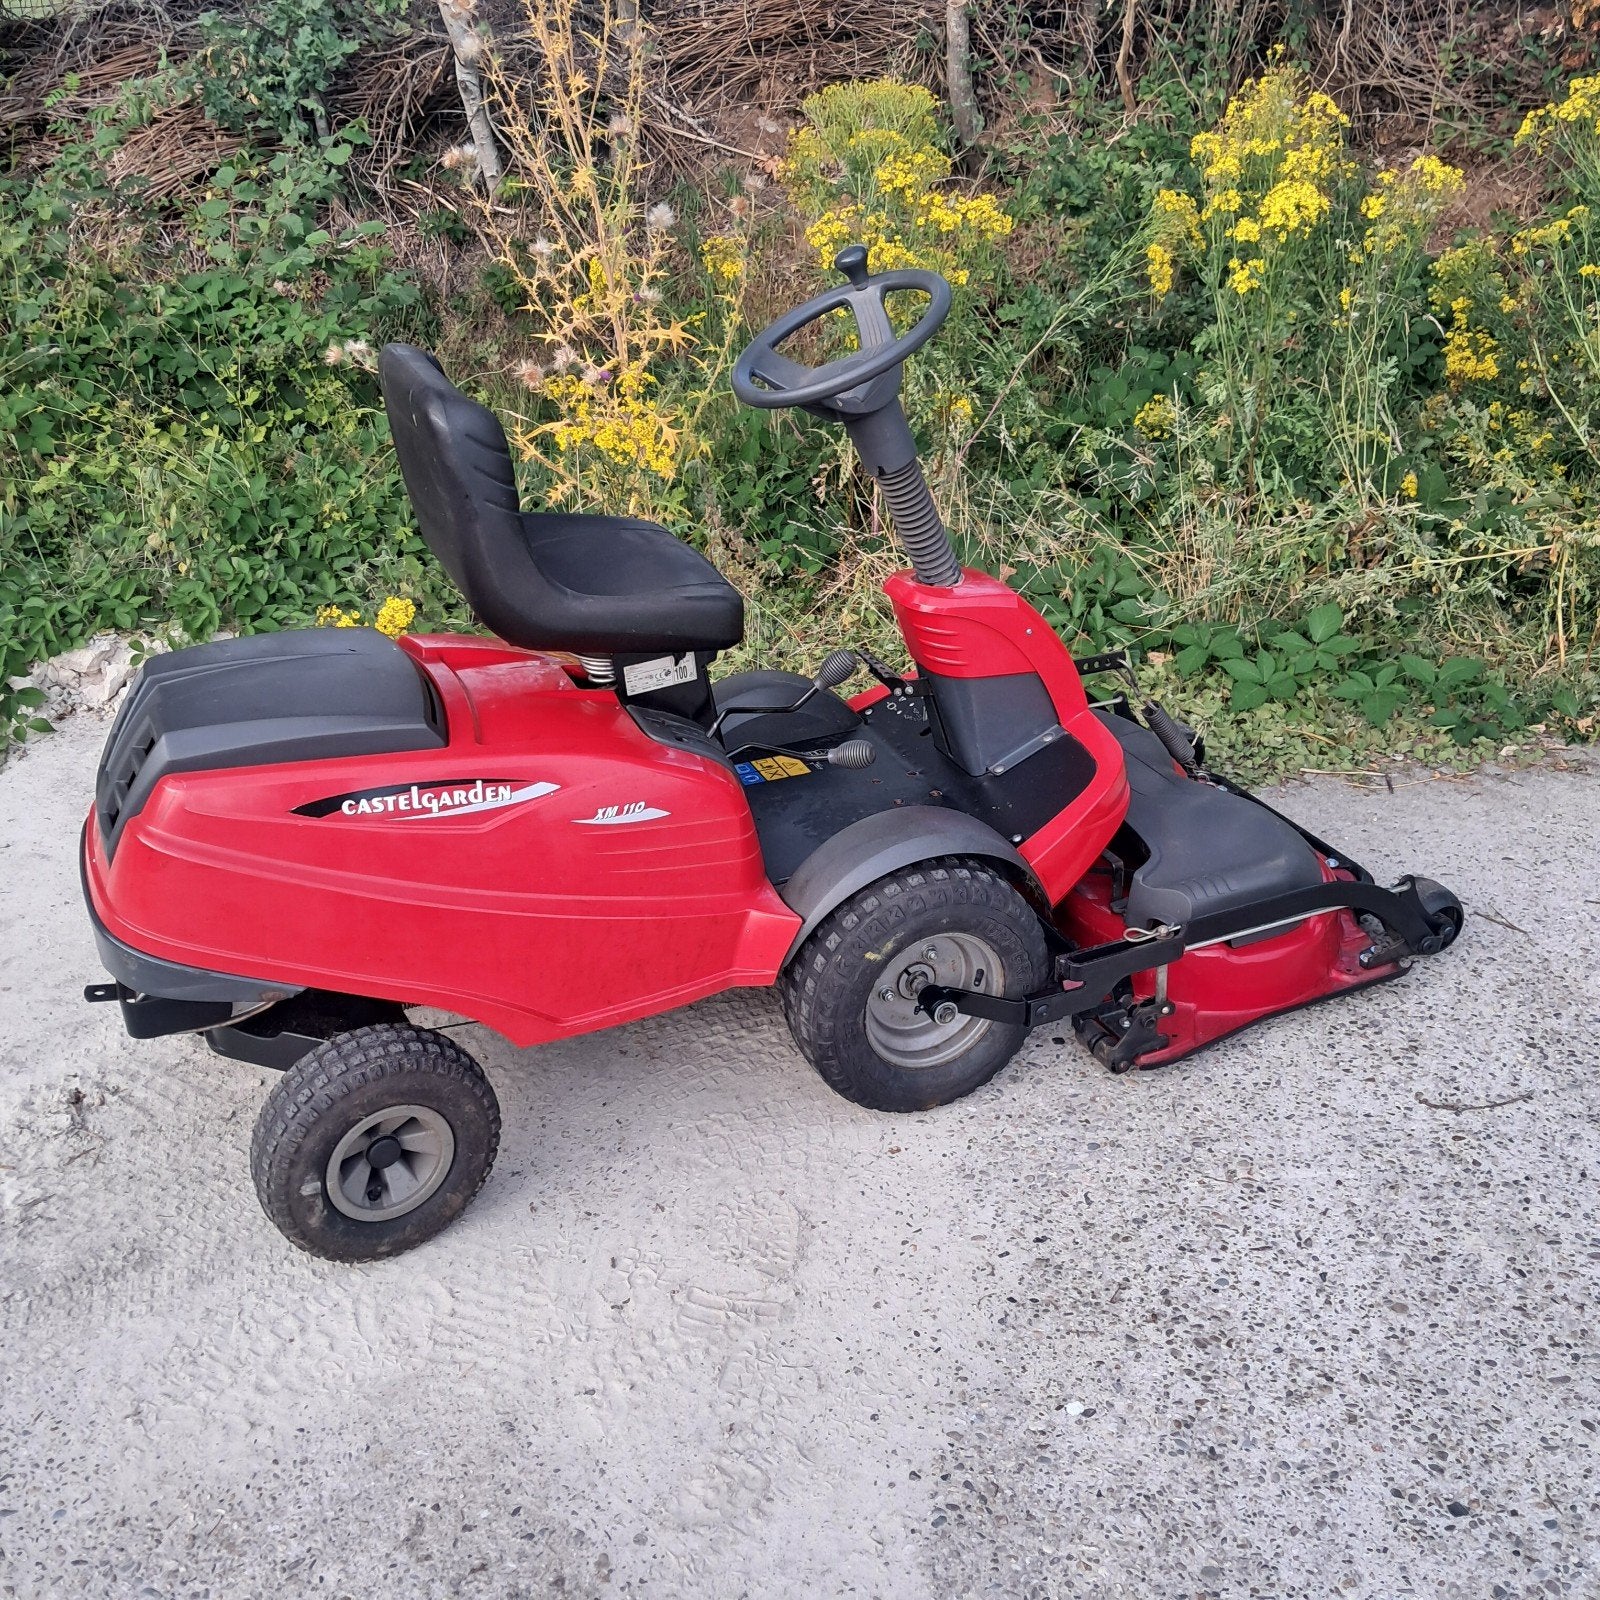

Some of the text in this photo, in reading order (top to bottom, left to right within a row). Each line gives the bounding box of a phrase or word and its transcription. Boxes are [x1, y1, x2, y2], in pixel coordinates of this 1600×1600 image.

[675, 665, 688, 680] 100
[594, 801, 646, 820] XM 110
